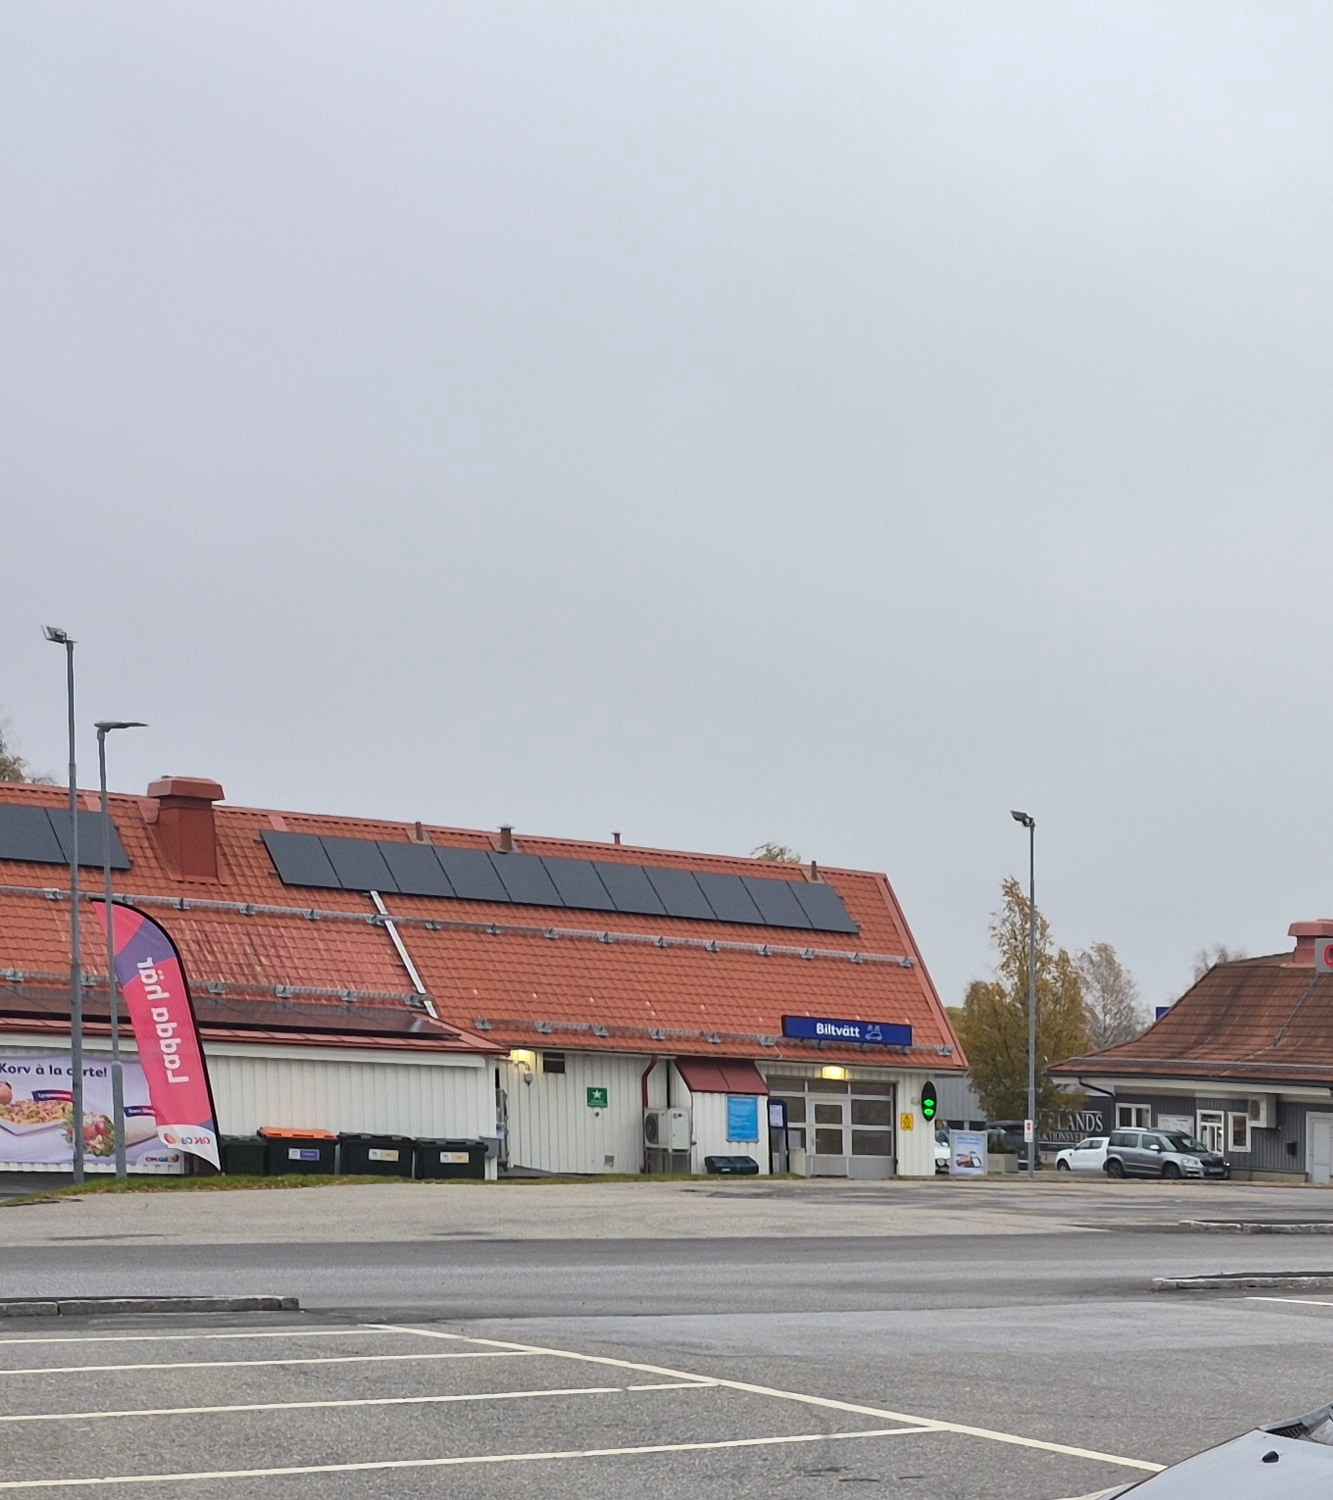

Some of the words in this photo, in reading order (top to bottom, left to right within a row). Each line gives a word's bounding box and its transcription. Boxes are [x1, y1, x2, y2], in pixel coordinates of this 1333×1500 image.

[816, 1023, 860, 1037] Biltvätt
[0, 1062, 31, 1075] Korv
[36, 1063, 44, 1075] à
[49, 1064, 62, 1076] la
[66, 1066, 107, 1078] crte!
